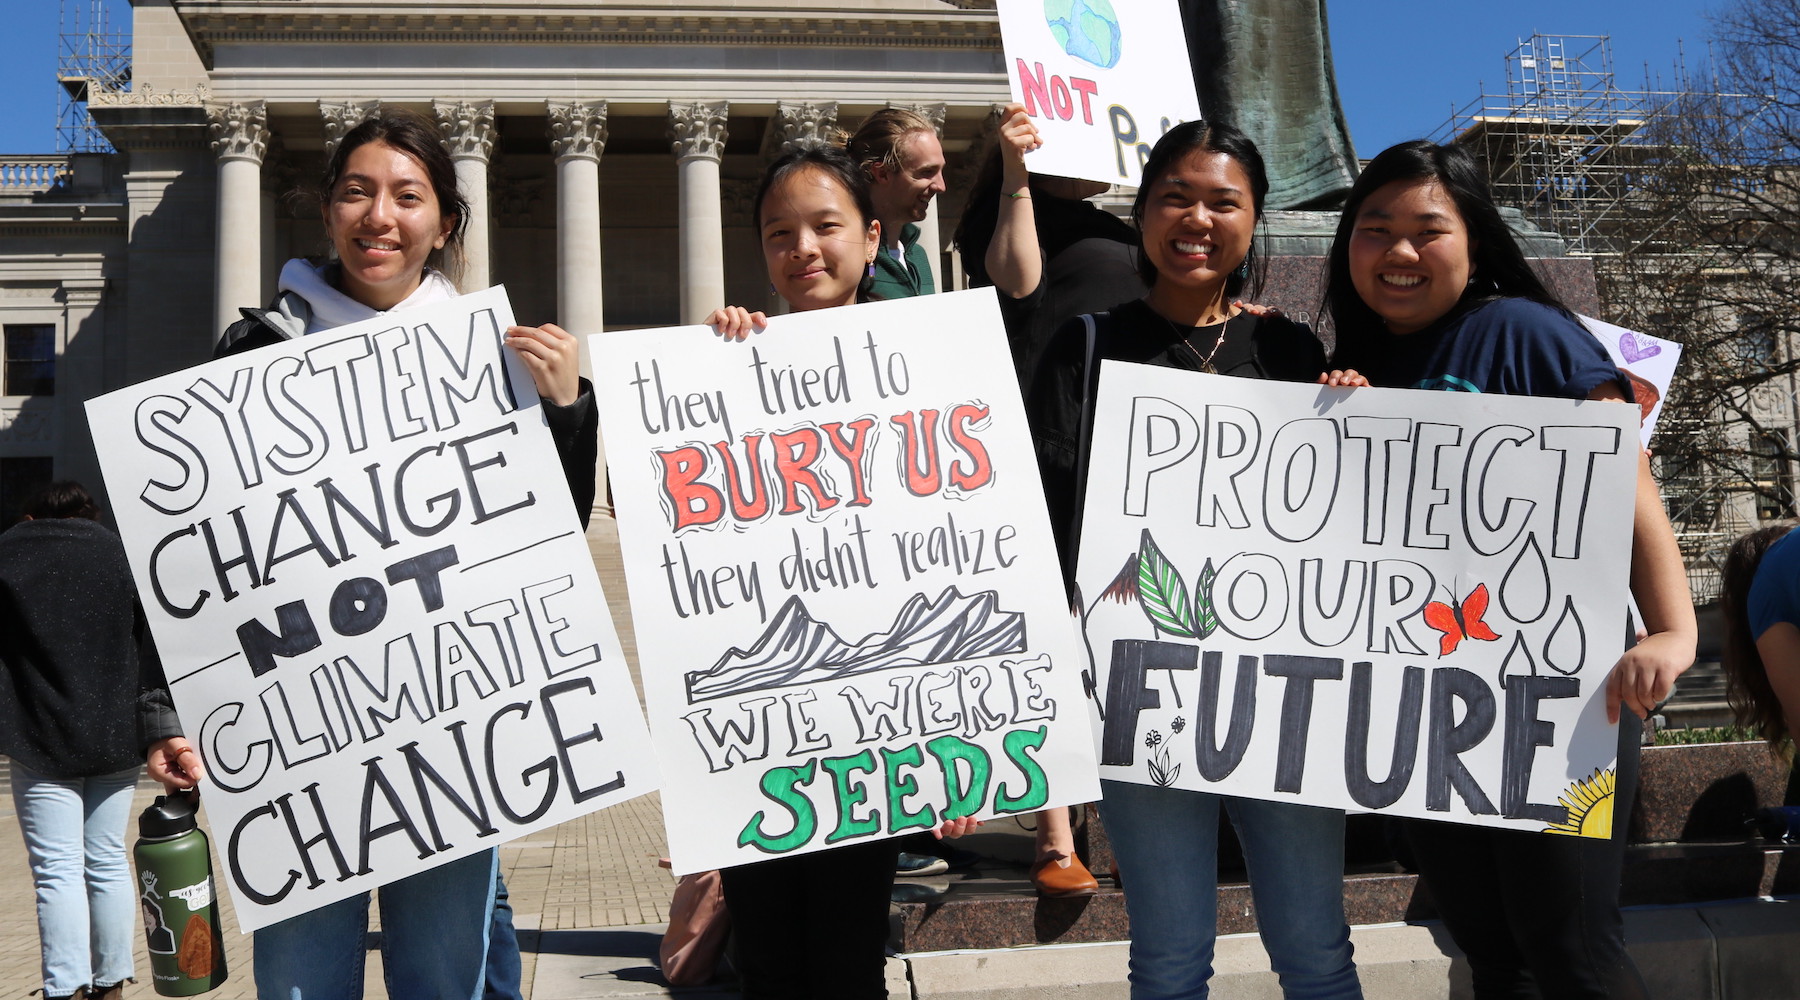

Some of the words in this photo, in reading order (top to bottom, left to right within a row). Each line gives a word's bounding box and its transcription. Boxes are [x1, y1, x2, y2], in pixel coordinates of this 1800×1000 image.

[1016, 58, 1099, 126] NOT
[134, 308, 518, 515] SYSTEM
[630, 357, 734, 445] they
[748, 335, 851, 416] tried
[862, 330, 910, 399] to
[149, 422, 536, 619] CHANGE
[656, 416, 876, 533] BURY
[889, 403, 992, 497] US
[1123, 396, 1622, 560] PROTECT
[236, 544, 459, 677] NOT
[660, 541, 767, 623] they
[779, 513, 878, 593] didn't
[892, 511, 1018, 582] realize
[1211, 551, 1437, 656] OUR
[199, 574, 602, 793] CLIMATE
[678, 690, 832, 773] WE
[838, 653, 1057, 742] WERE
[1100, 639, 1581, 825] FUTURE
[227, 676, 626, 906] CHANGE
[737, 724, 1050, 853] SEEDS
